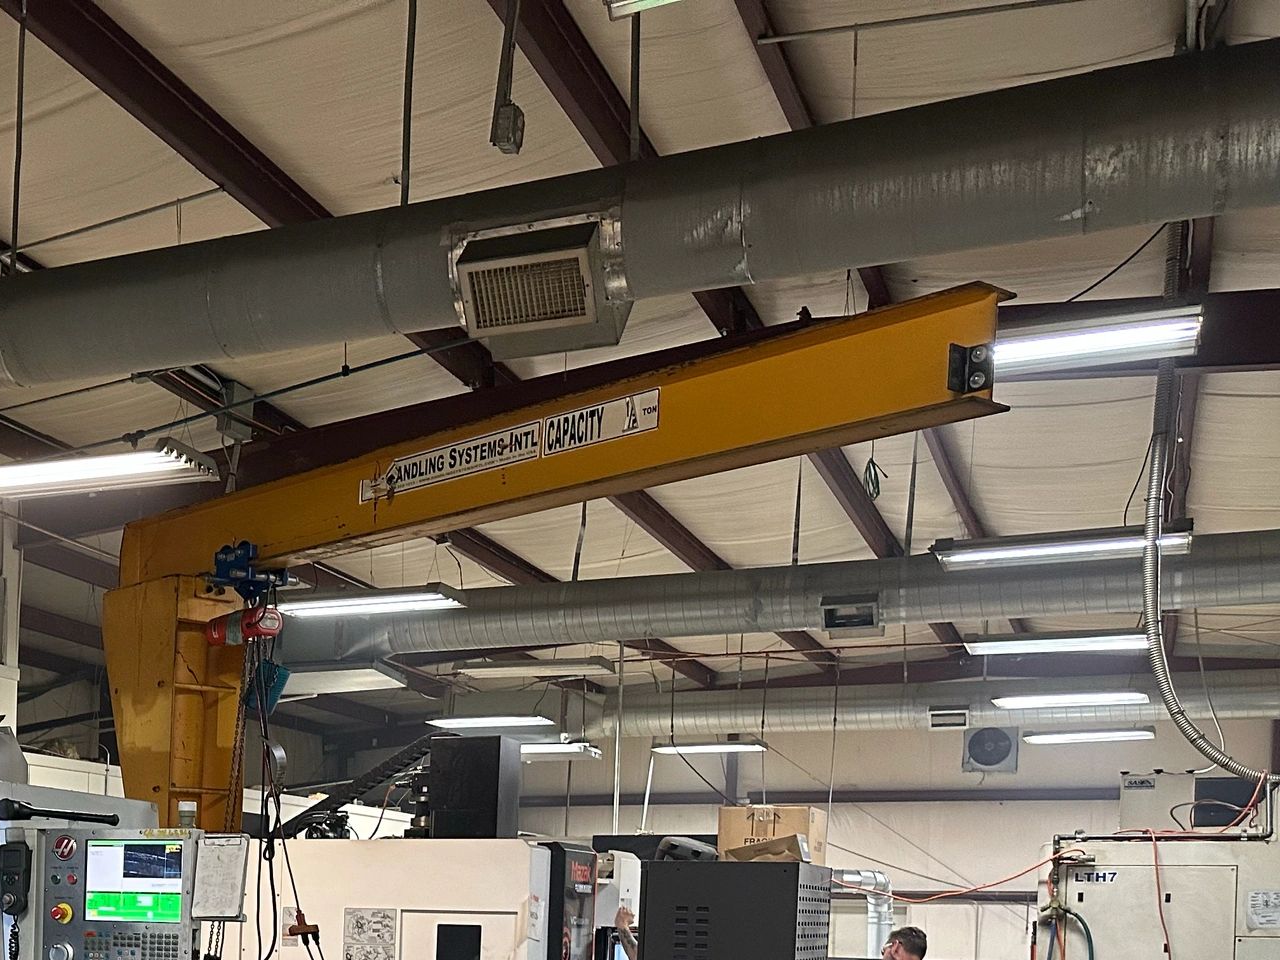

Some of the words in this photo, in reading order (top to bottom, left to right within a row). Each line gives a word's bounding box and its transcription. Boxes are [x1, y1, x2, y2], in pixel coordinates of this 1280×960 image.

[547, 407, 604, 451] CAPACITY
[642, 405, 657, 416] TON
[389, 459, 444, 484] ANDLING
[448, 437, 504, 468] SYSTEMS
[509, 430, 538, 453] INTL
[571, 861, 592, 882] Mazak
[1074, 872, 1117, 882] LTH7
